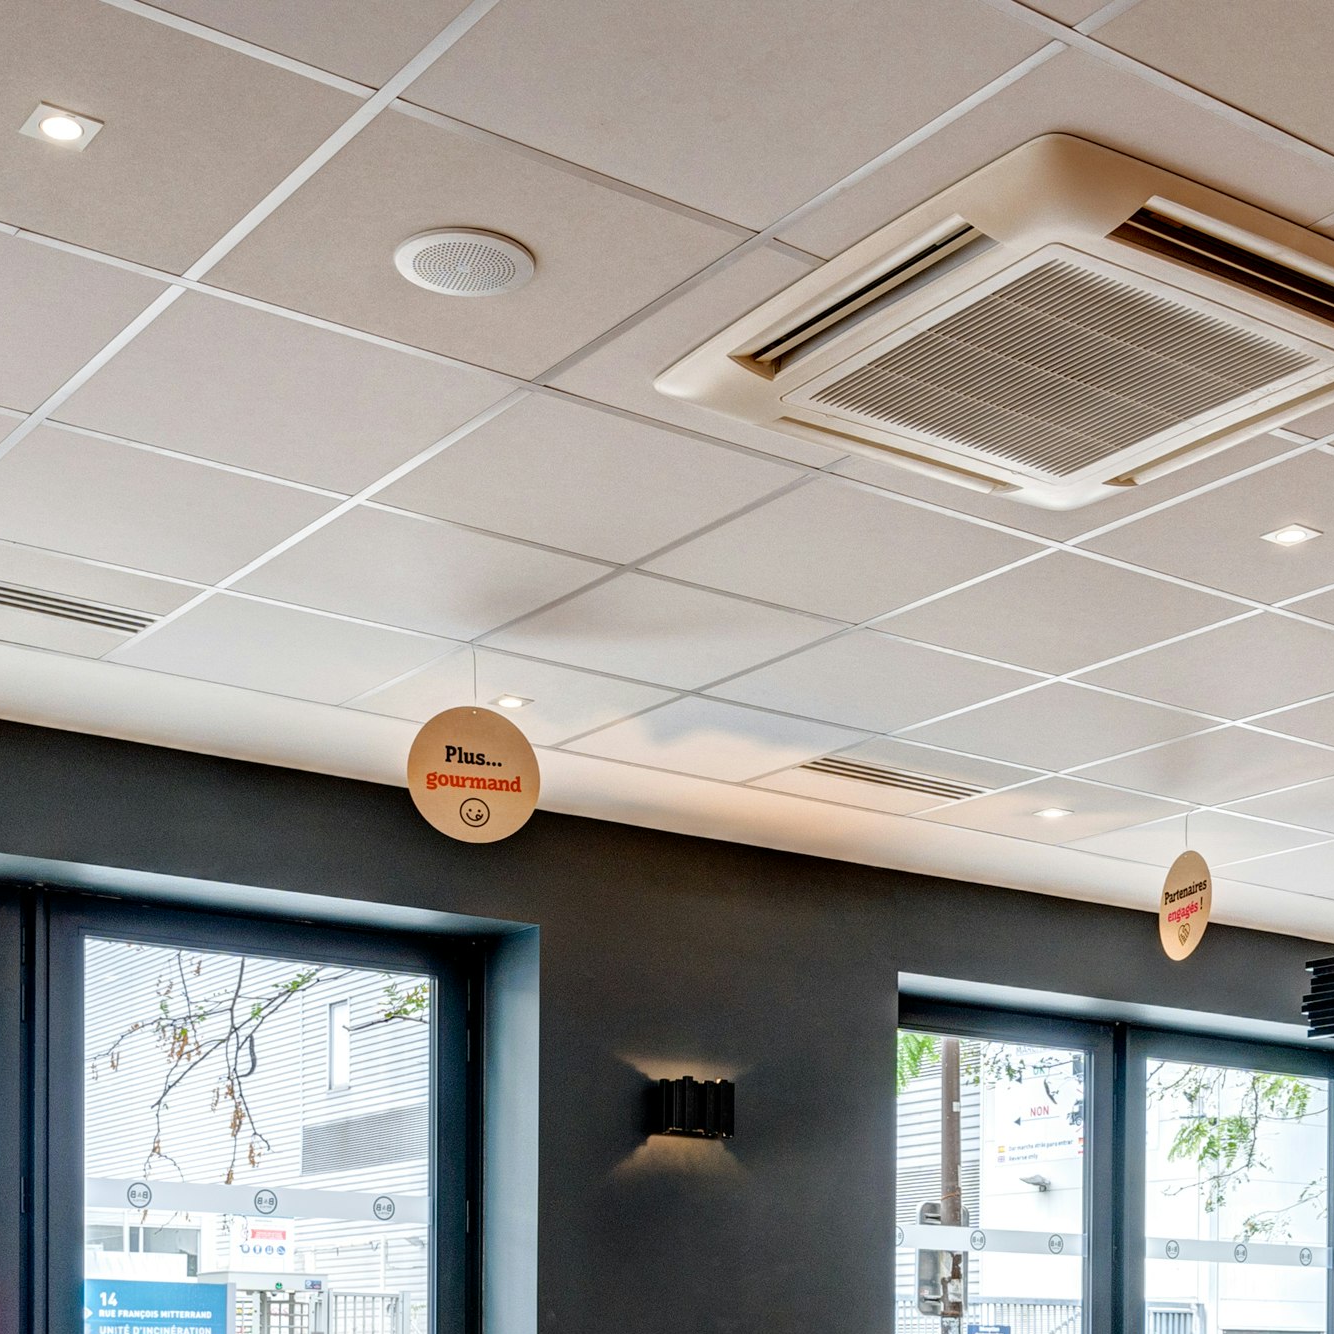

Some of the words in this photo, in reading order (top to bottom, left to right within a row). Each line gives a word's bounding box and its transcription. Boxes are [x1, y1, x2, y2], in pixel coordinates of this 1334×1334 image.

[445, 745, 502, 767] Plus...
[426, 771, 521, 792] gourmand
[1164, 880, 1207, 905] Partenaires
[1168, 901, 1198, 922] engagés
[1030, 1106, 1049, 1117] NON
[100, 1292, 118, 1306] 14
[99, 1310, 116, 1318] RUE
[118, 1310, 159, 1319] FRANÇOIS
[160, 1310, 212, 1318] MITTERRAND
[99, 1324, 129, 1334] UNITÉ
